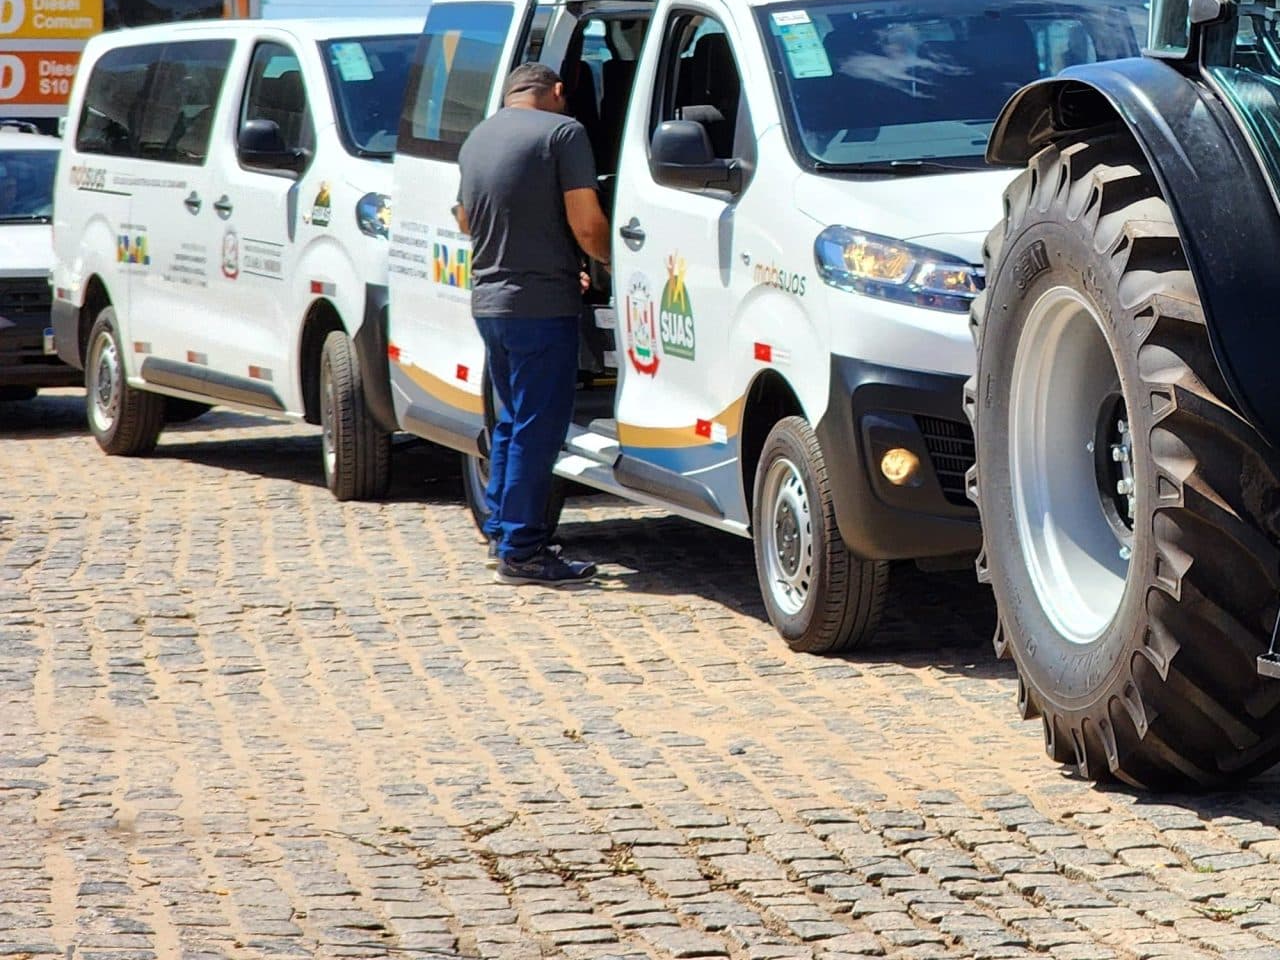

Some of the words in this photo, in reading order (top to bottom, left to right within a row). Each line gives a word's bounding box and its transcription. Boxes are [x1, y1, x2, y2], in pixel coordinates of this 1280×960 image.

[34, 13, 93, 29] Comum
[0, 54, 26, 100] D
[38, 60, 76, 77] Dies
[39, 78, 69, 95] S10
[660, 309, 694, 349] SUAS
